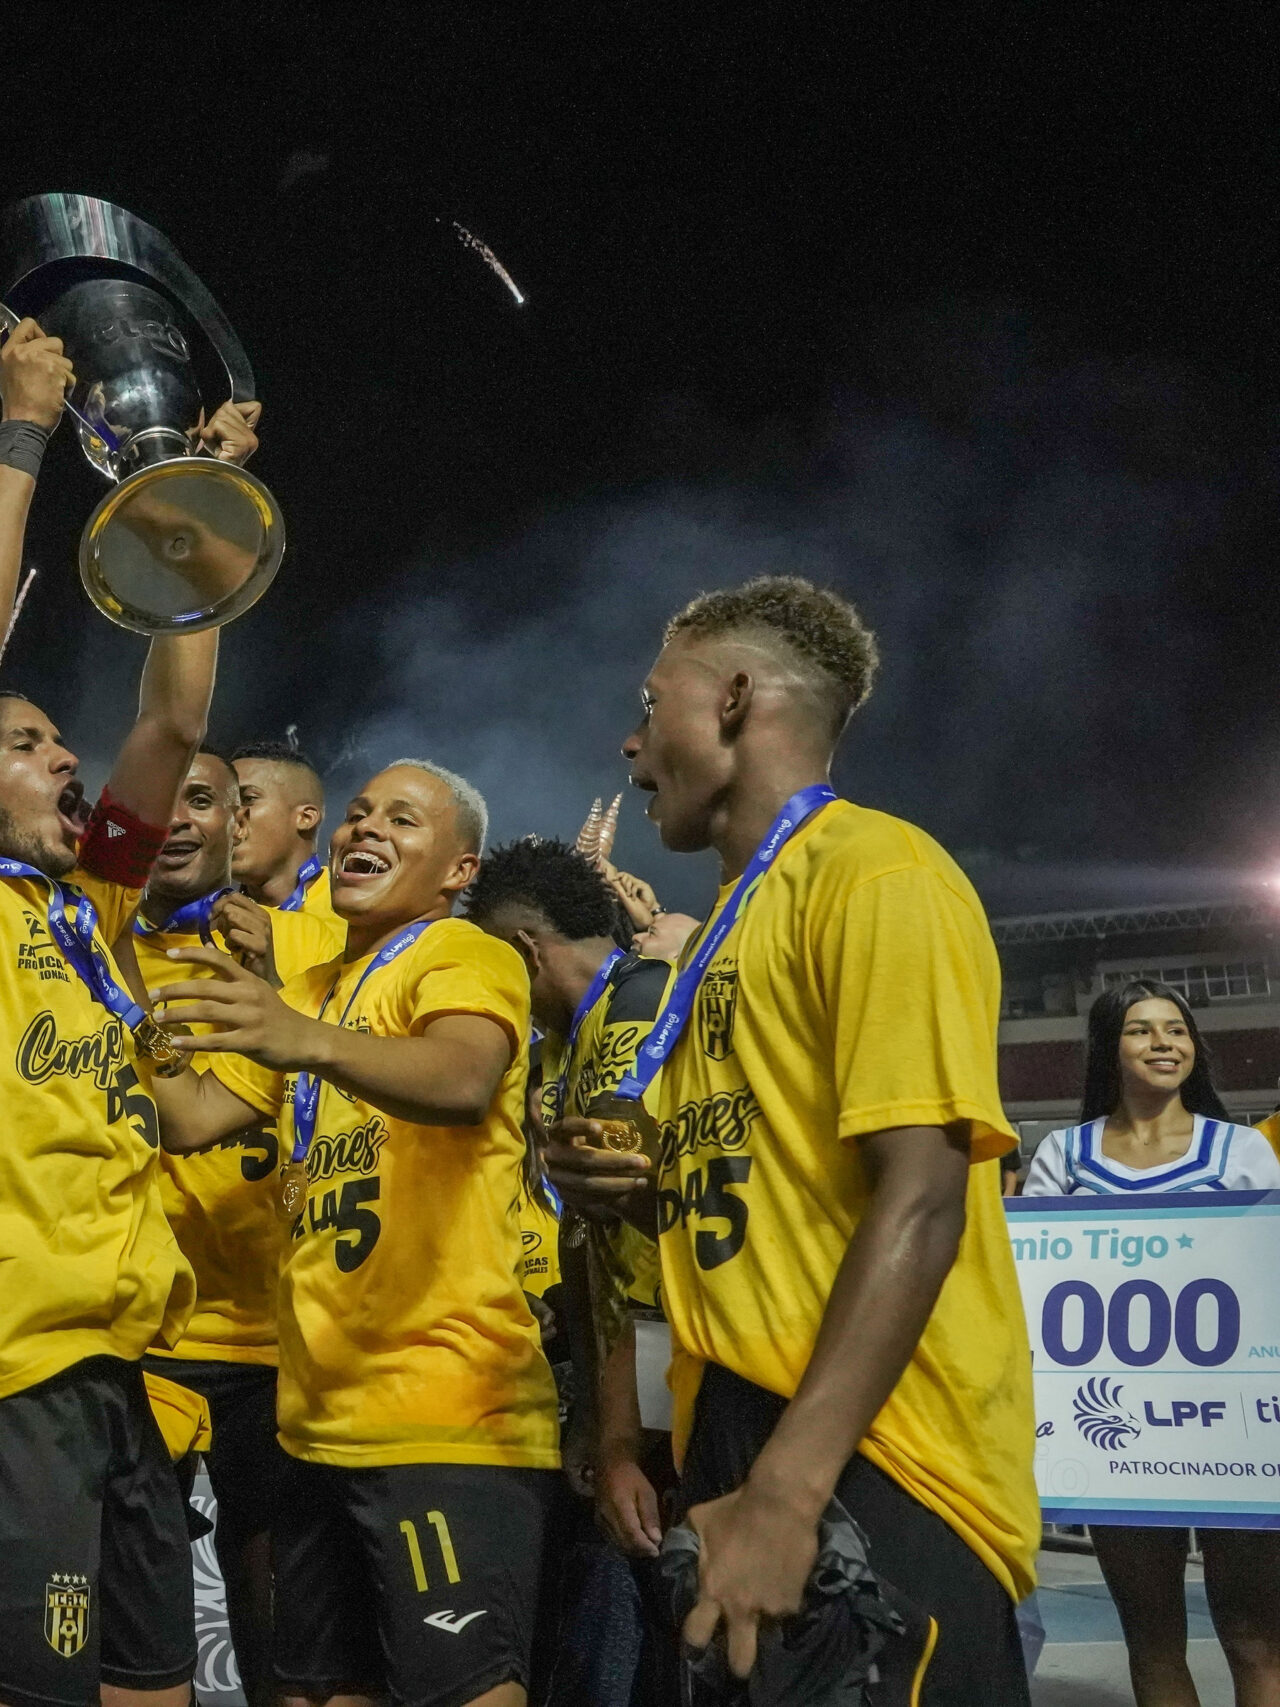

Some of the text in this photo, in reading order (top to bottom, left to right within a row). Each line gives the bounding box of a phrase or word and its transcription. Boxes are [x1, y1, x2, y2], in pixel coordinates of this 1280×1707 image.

[334, 1175, 382, 1274] 5
[695, 1155, 753, 1271] 5
[1082, 1227, 1169, 1268] Tigo
[1143, 1401, 1227, 1428] LPF
[1109, 1460, 1280, 1478] PATROCINADOR O
[399, 1509, 461, 1593] 11
[58, 1594, 82, 1606] CAI
